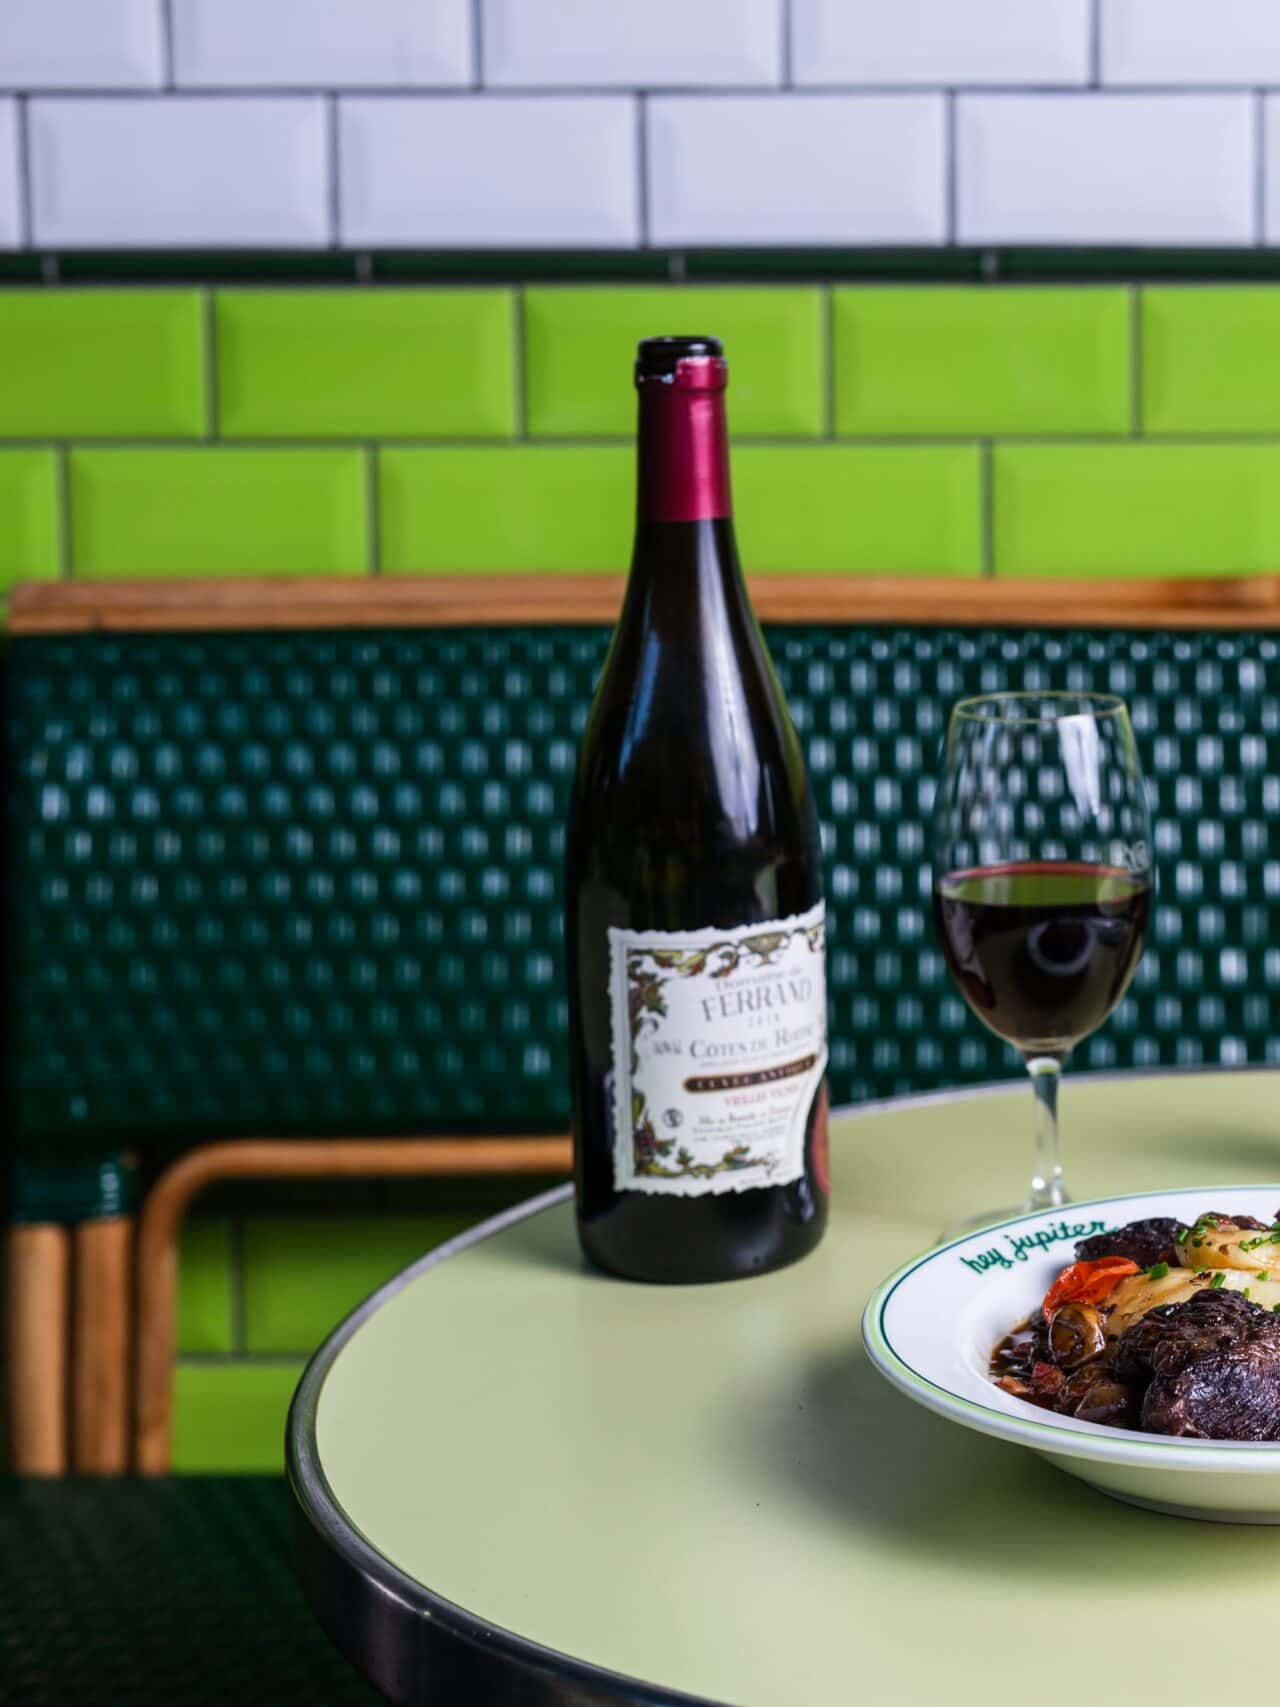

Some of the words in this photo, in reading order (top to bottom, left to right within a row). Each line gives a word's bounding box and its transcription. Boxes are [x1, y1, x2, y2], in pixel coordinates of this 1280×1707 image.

[702, 978, 812, 1021] FERRAND
[959, 1248, 1014, 1274] hey
[1004, 1221, 1107, 1261] jupiter
